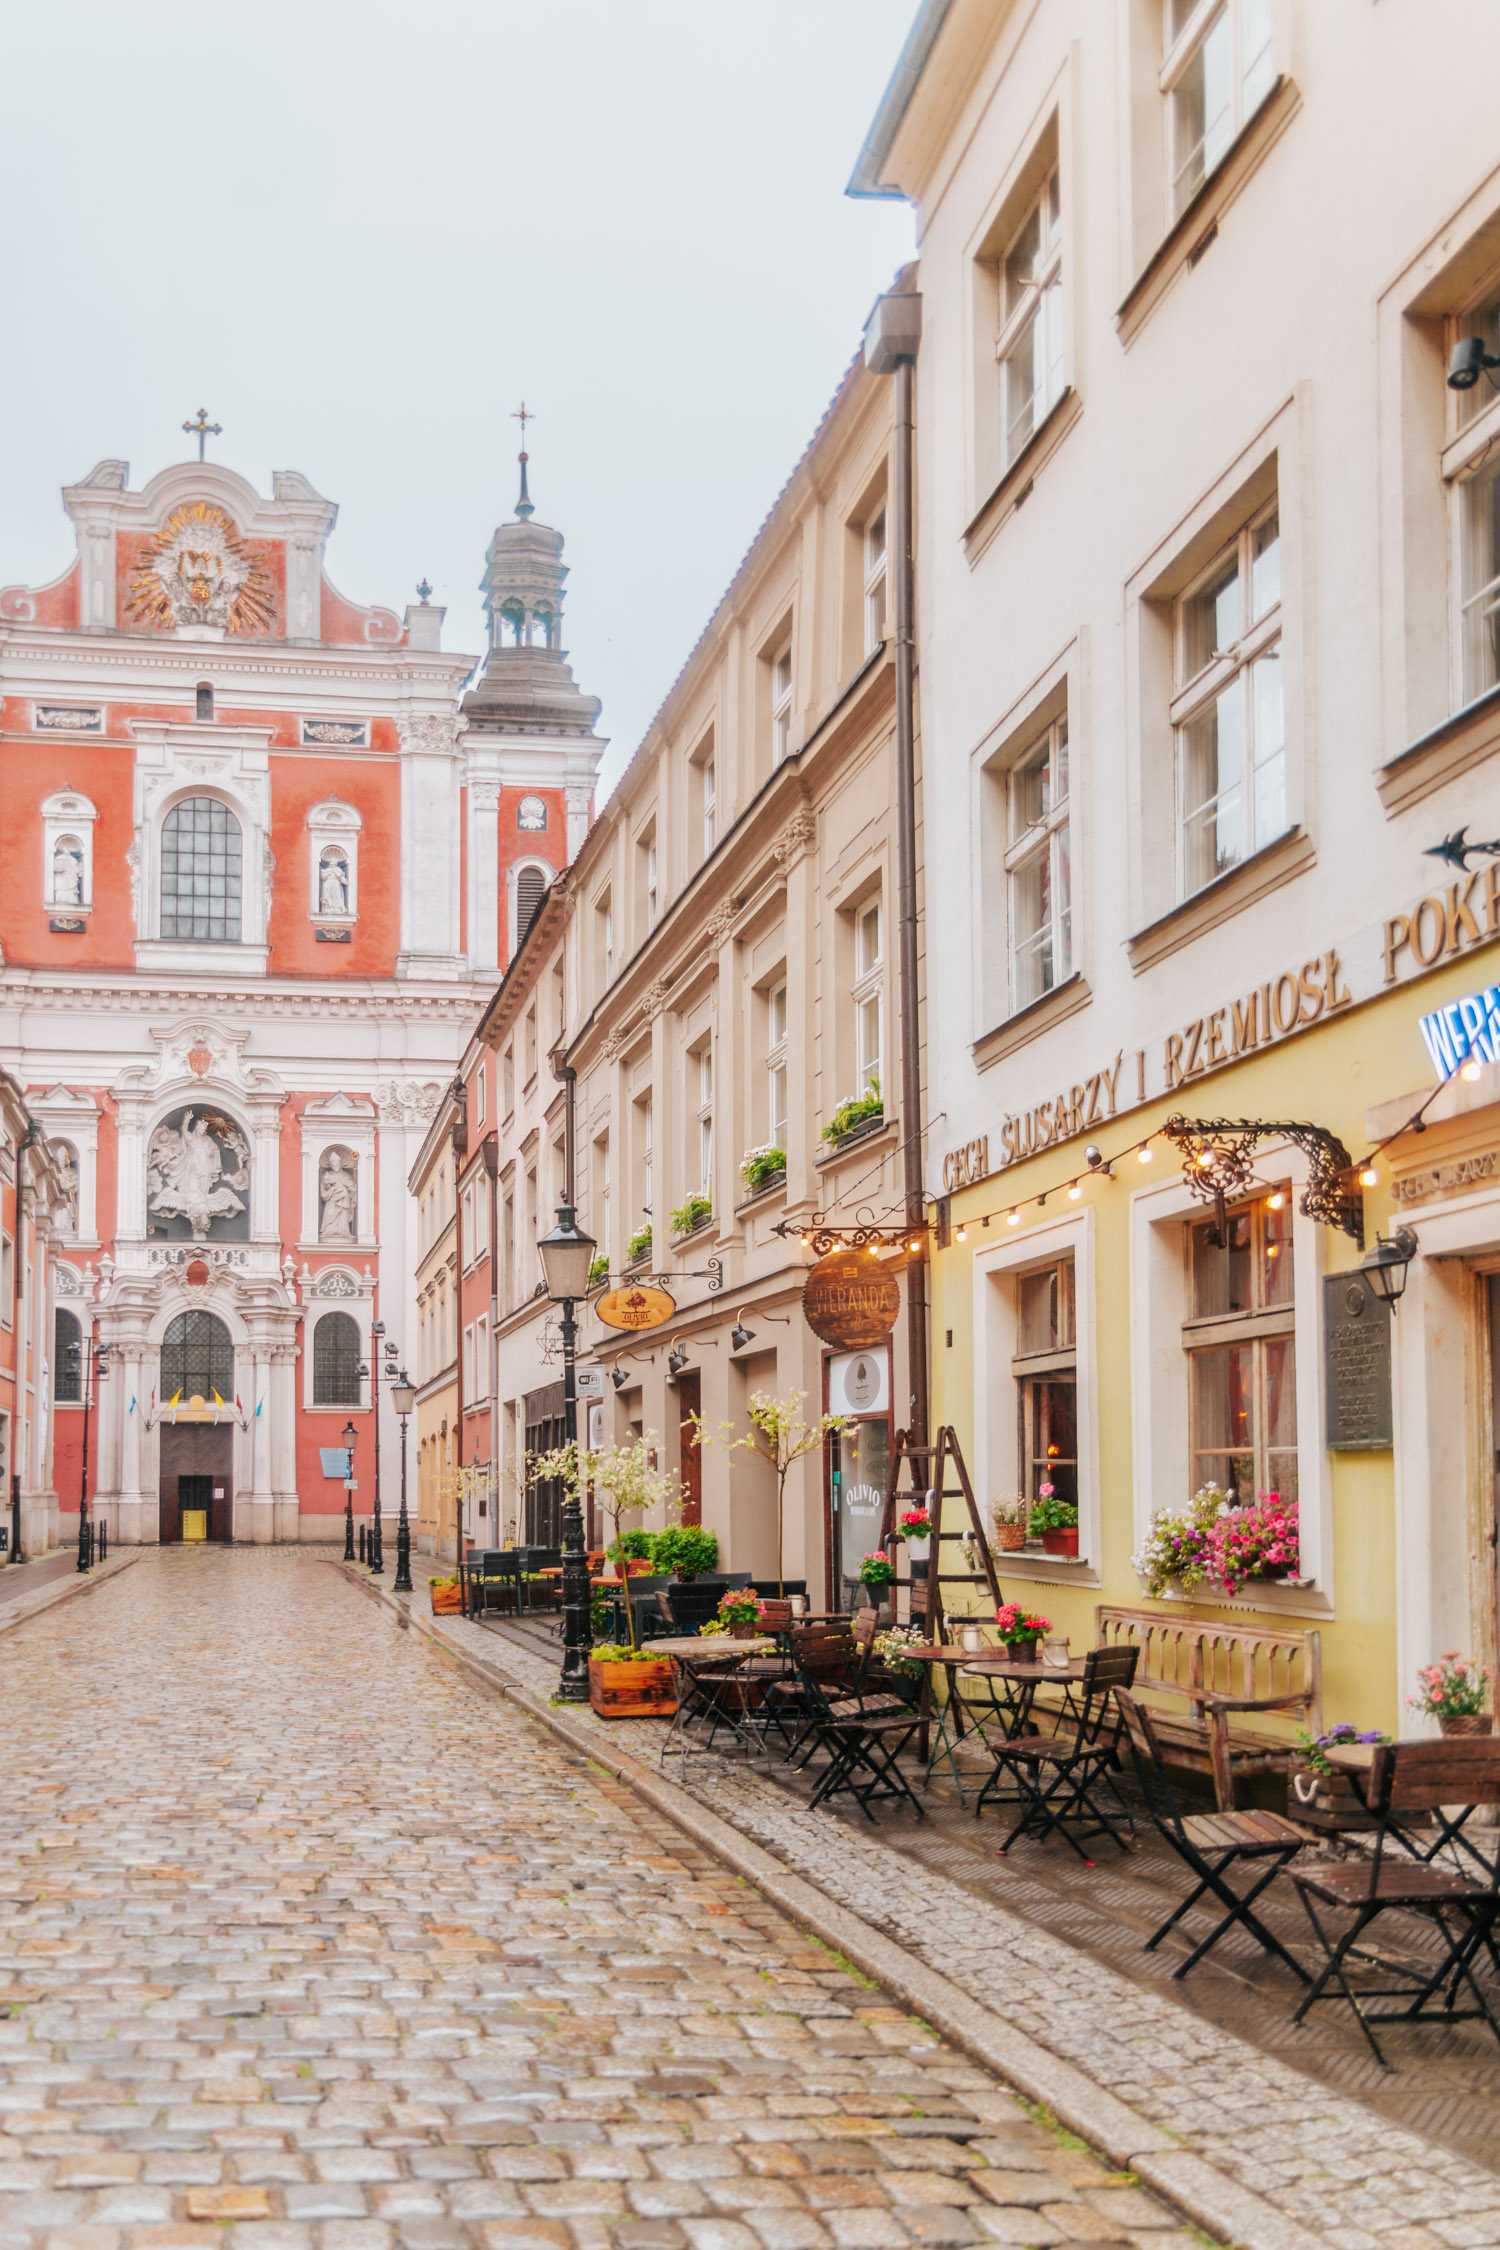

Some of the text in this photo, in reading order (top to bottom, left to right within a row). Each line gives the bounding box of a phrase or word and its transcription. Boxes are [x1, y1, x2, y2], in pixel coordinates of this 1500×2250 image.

[942, 1134, 988, 1191] CECH
[1001, 1049, 1123, 1165] ŚLUSARZY
[1136, 1050, 1146, 1100] I
[1163, 948, 1352, 1088] RZEMIOSŁ
[815, 1285, 890, 1314] WERANDA
[624, 1313, 649, 1321] OLIVIO
[846, 1484, 880, 1507] OLIVIO
